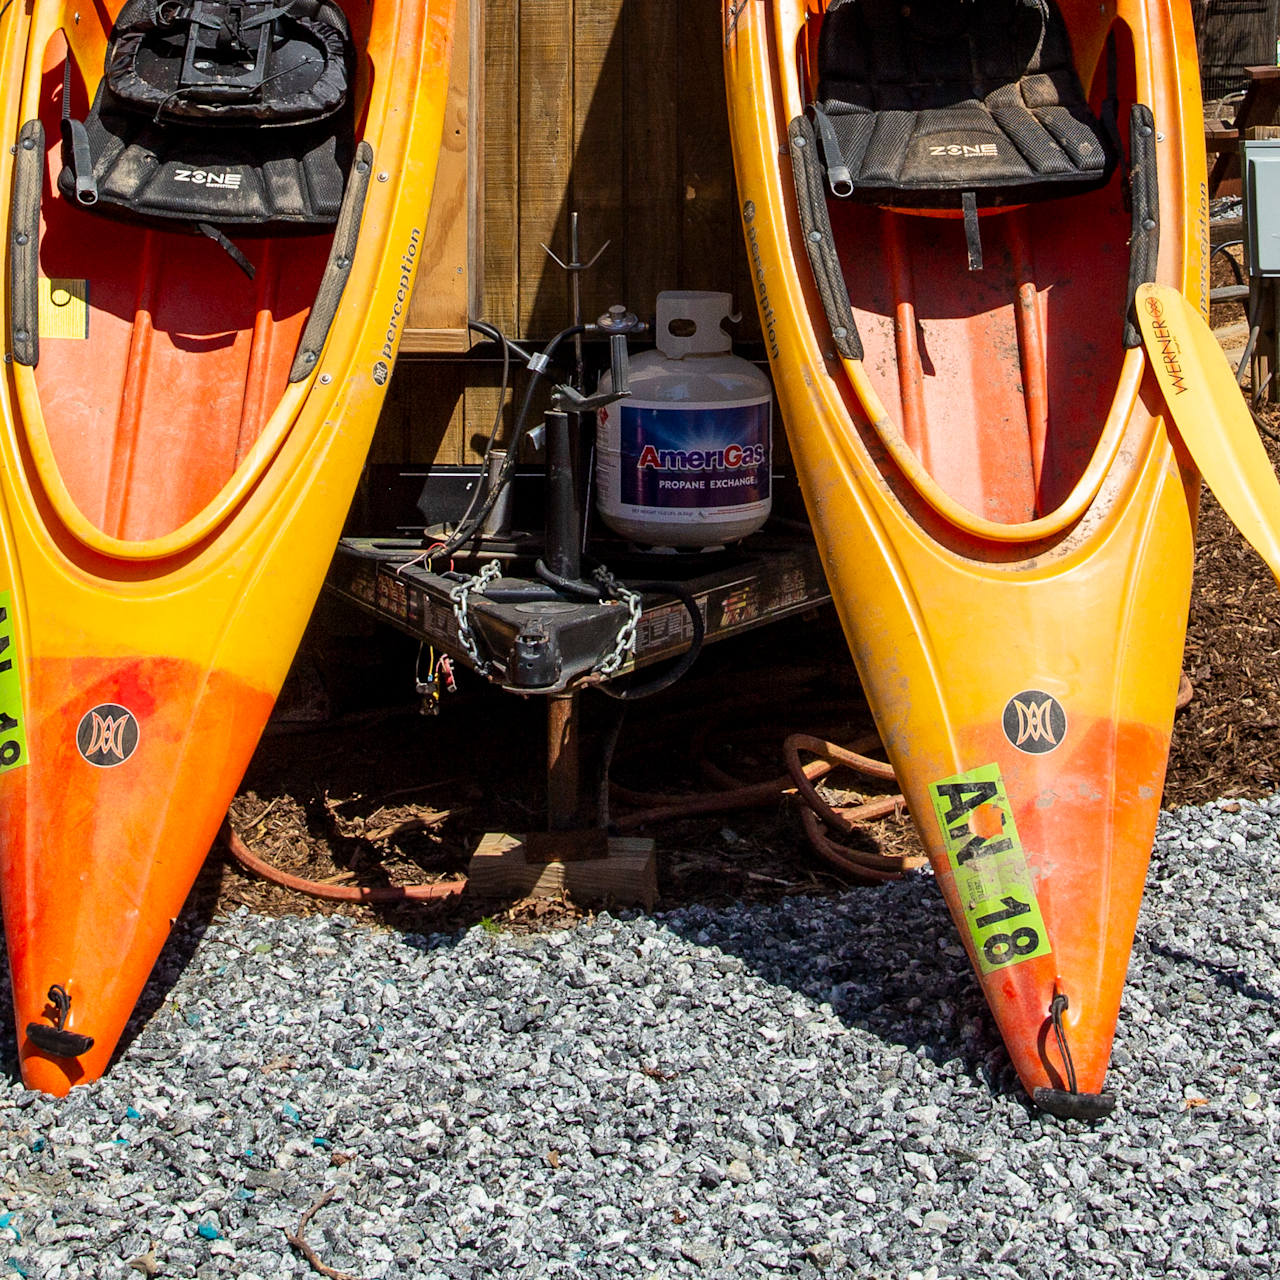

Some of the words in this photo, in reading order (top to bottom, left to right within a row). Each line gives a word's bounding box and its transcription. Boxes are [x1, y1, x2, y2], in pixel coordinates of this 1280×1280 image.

[173, 169, 241, 184] ZONE
[928, 143, 998, 156] ZONE
[1198, 181, 1209, 314] perception
[382, 228, 421, 360] perception
[747, 227, 781, 360] perception
[1152, 319, 1188, 396] WERNER
[637, 443, 764, 471] AmeriGas
[659, 480, 706, 489] PROPANE
[709, 476, 755, 489] EXCHANGE
[936, 781, 1014, 865] AN
[975, 896, 1040, 964] 18
